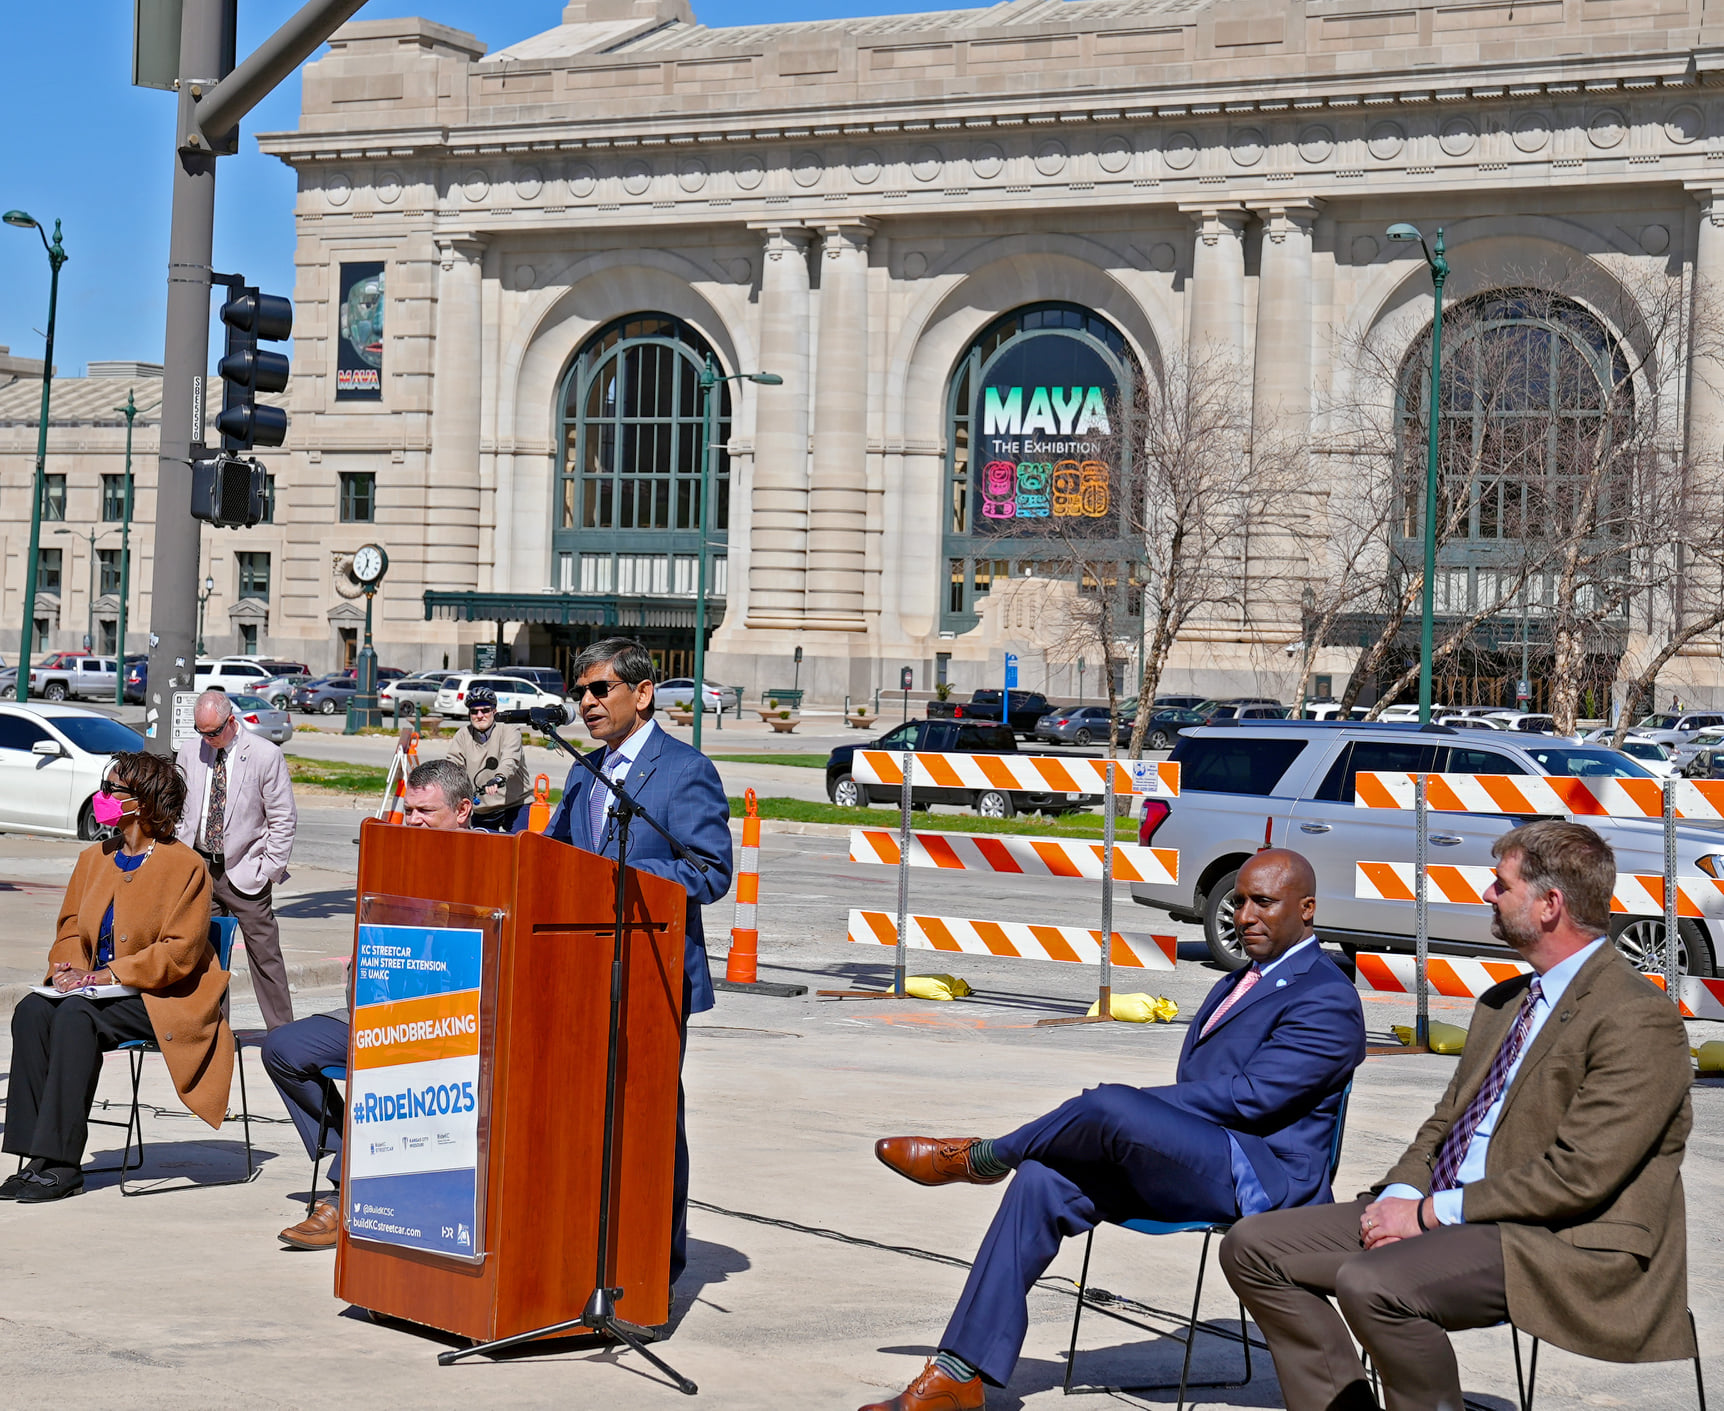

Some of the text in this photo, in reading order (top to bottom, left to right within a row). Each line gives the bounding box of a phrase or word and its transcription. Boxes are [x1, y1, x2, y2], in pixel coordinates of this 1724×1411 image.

[338, 369, 380, 390] MAYA
[983, 386, 1112, 436] MAYA
[361, 944, 411, 956] KC STREETCAR
[360, 957, 447, 972] MAIN STREET EXTENSION
[368, 969, 390, 980] UMKC
[356, 1014, 476, 1048] GROUNDBREAKING
[353, 1216, 422, 1238] buildKCstreetcar.com
